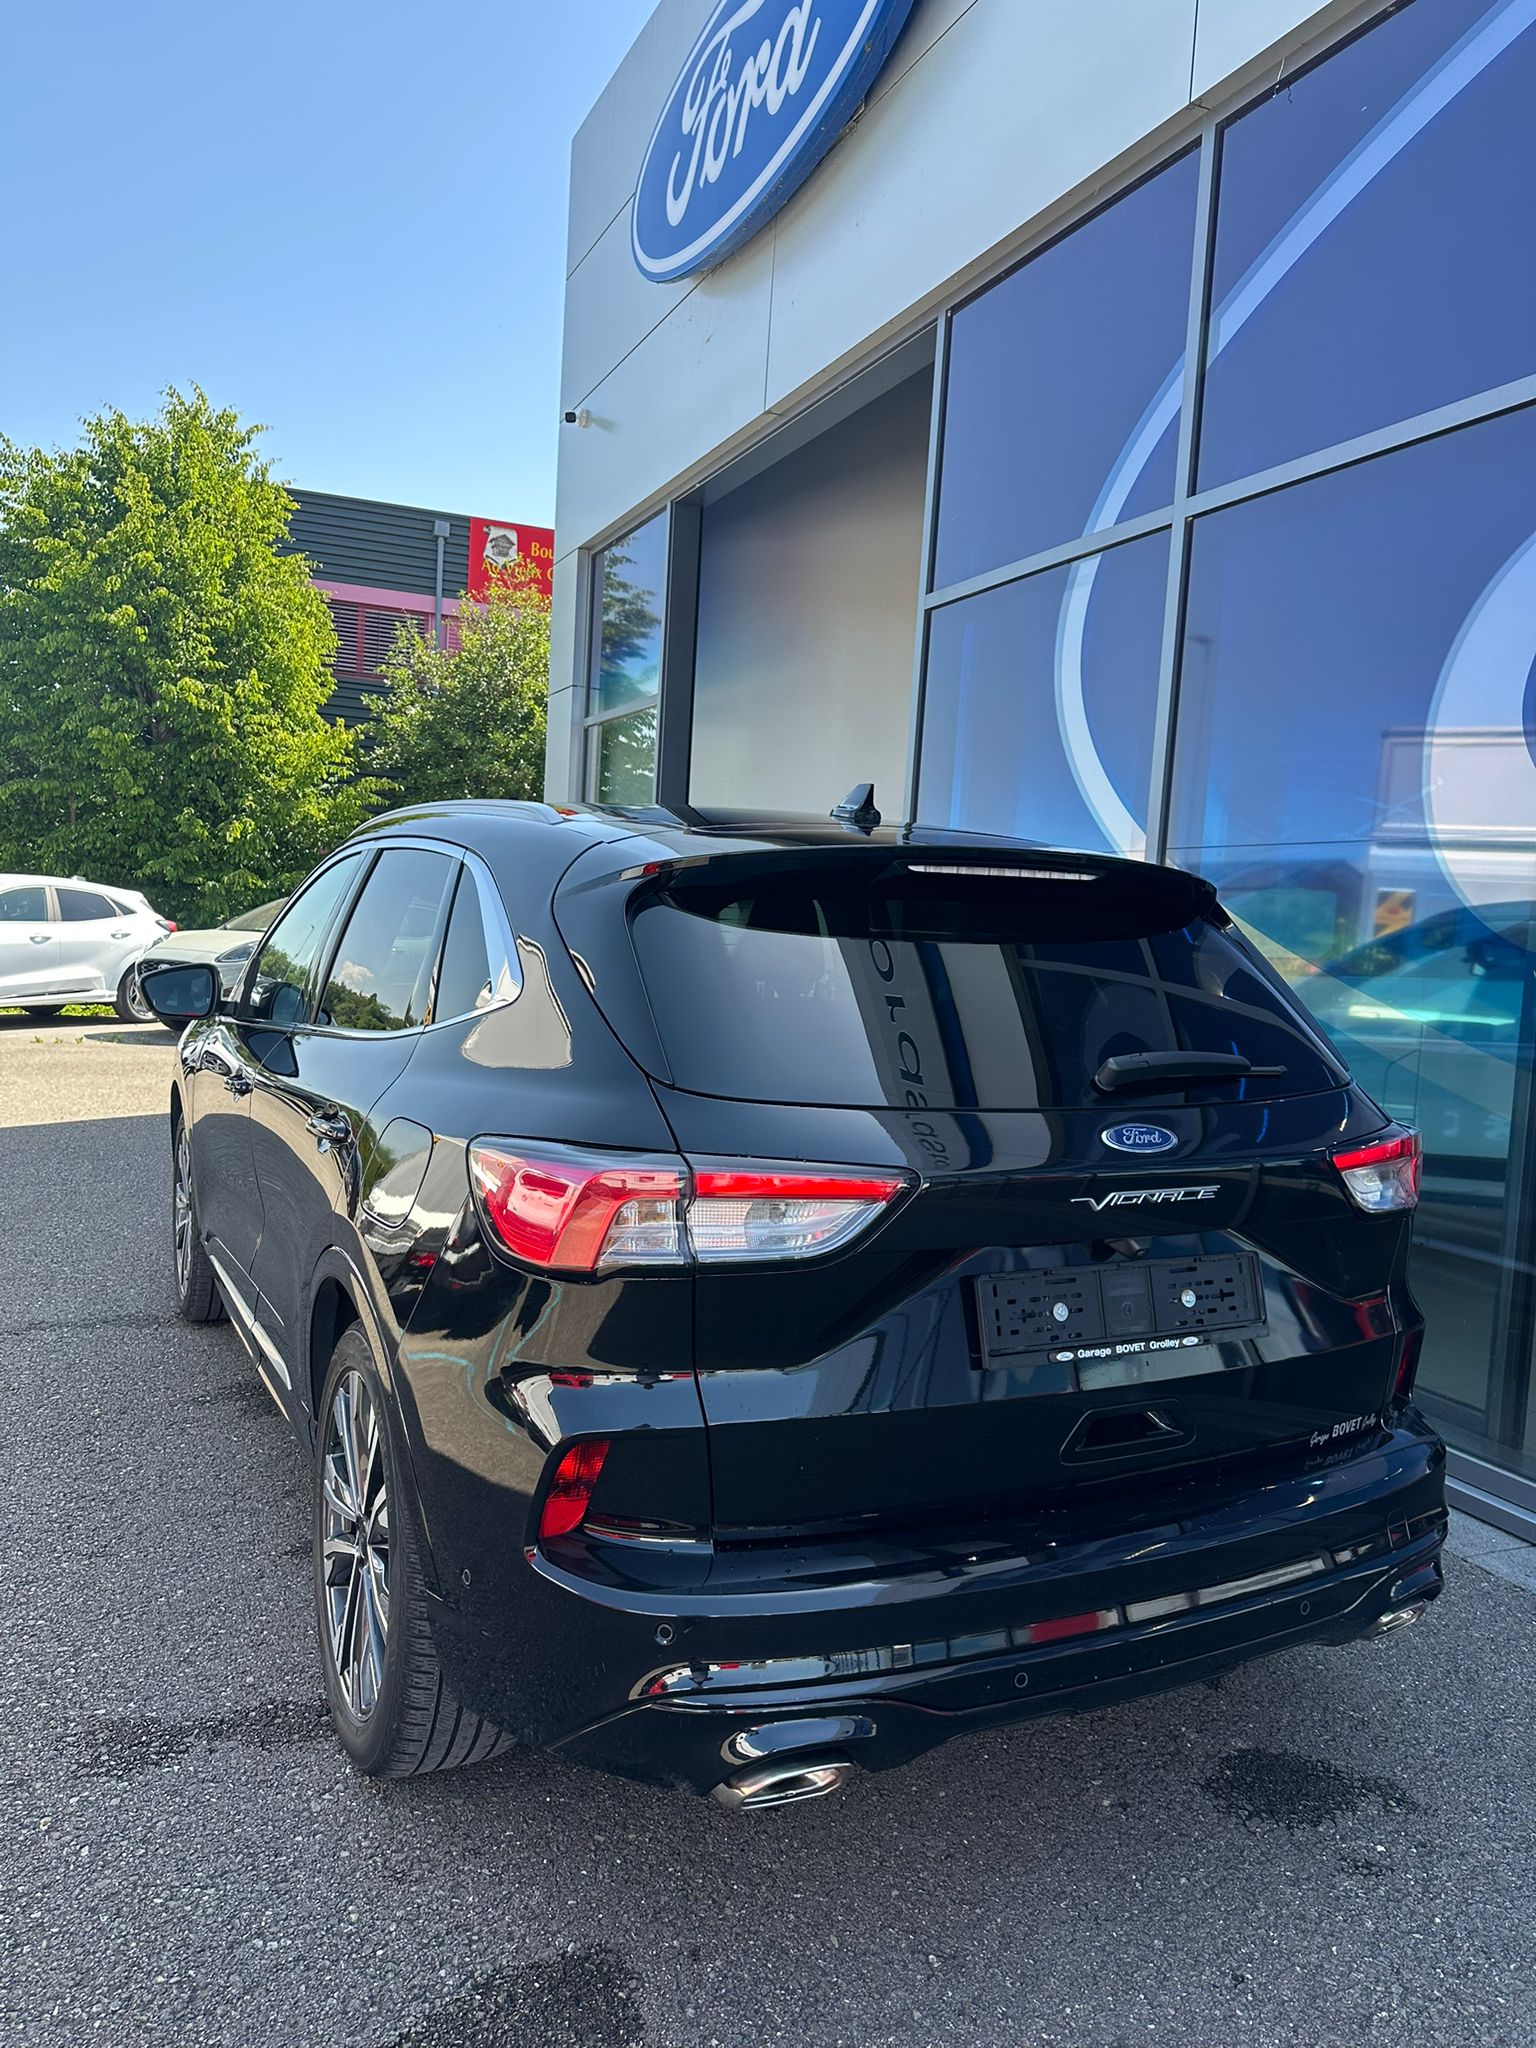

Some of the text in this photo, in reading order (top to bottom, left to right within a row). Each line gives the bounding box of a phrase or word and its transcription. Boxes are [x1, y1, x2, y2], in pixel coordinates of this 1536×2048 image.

[666, 0, 821, 227] Ford
[1122, 1127, 1162, 1144] Ford
[1071, 1185, 1221, 1211] VIGNALE
[1077, 1347, 1111, 1359] Garage
[1116, 1342, 1146, 1354] BOVET
[1150, 1338, 1180, 1349] Grolley
[1332, 1416, 1362, 1438] BOVET
